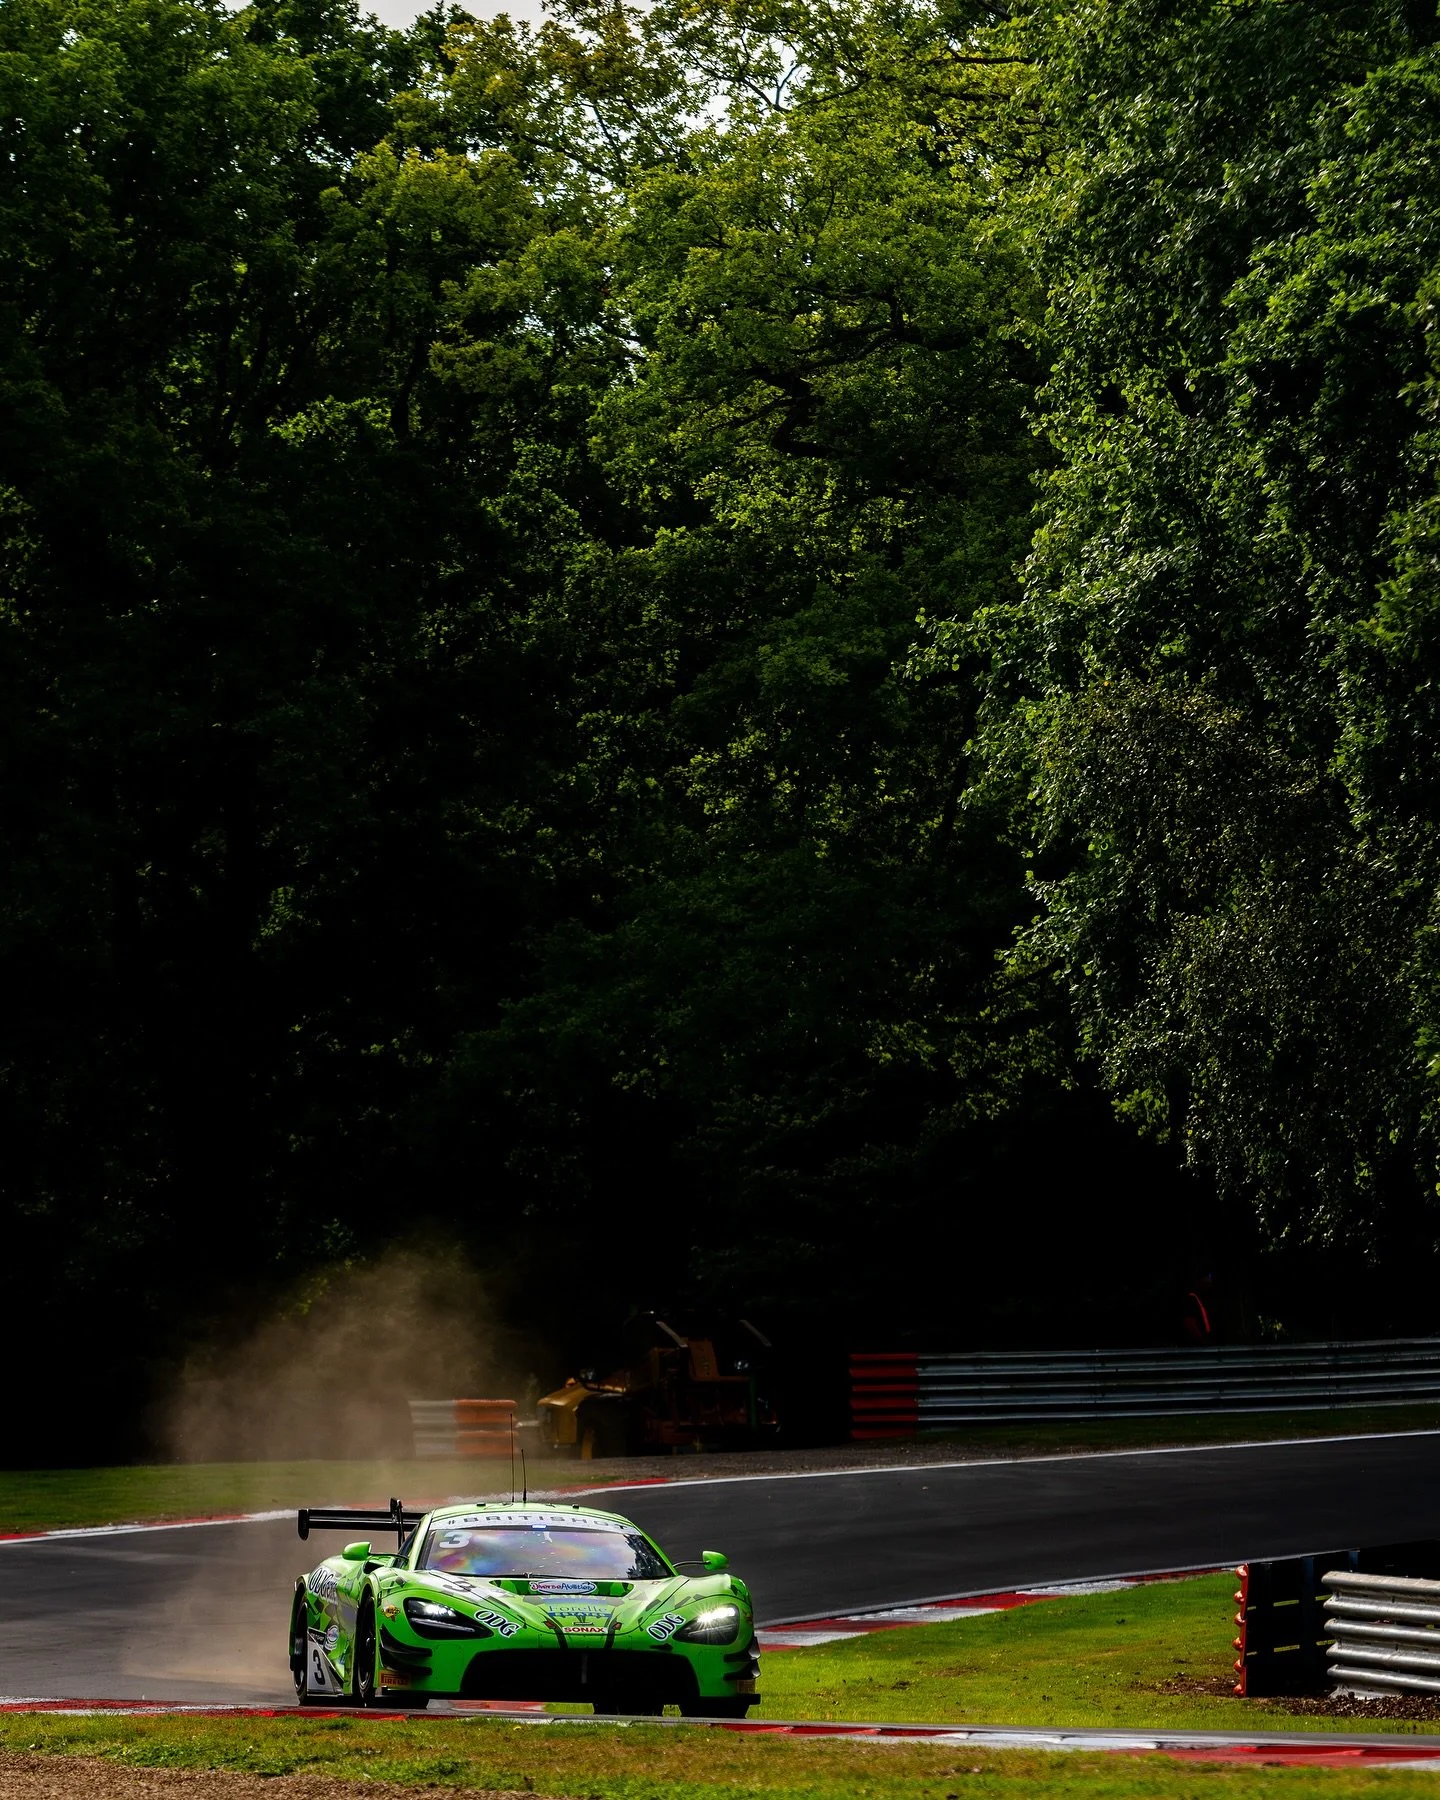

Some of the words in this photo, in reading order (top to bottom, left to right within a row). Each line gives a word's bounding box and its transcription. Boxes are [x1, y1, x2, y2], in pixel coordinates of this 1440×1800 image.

[439, 1531, 473, 1549] 3
[475, 1610, 520, 1637] ODG
[648, 1613, 685, 1640] ODG
[312, 1649, 326, 1686] 3
